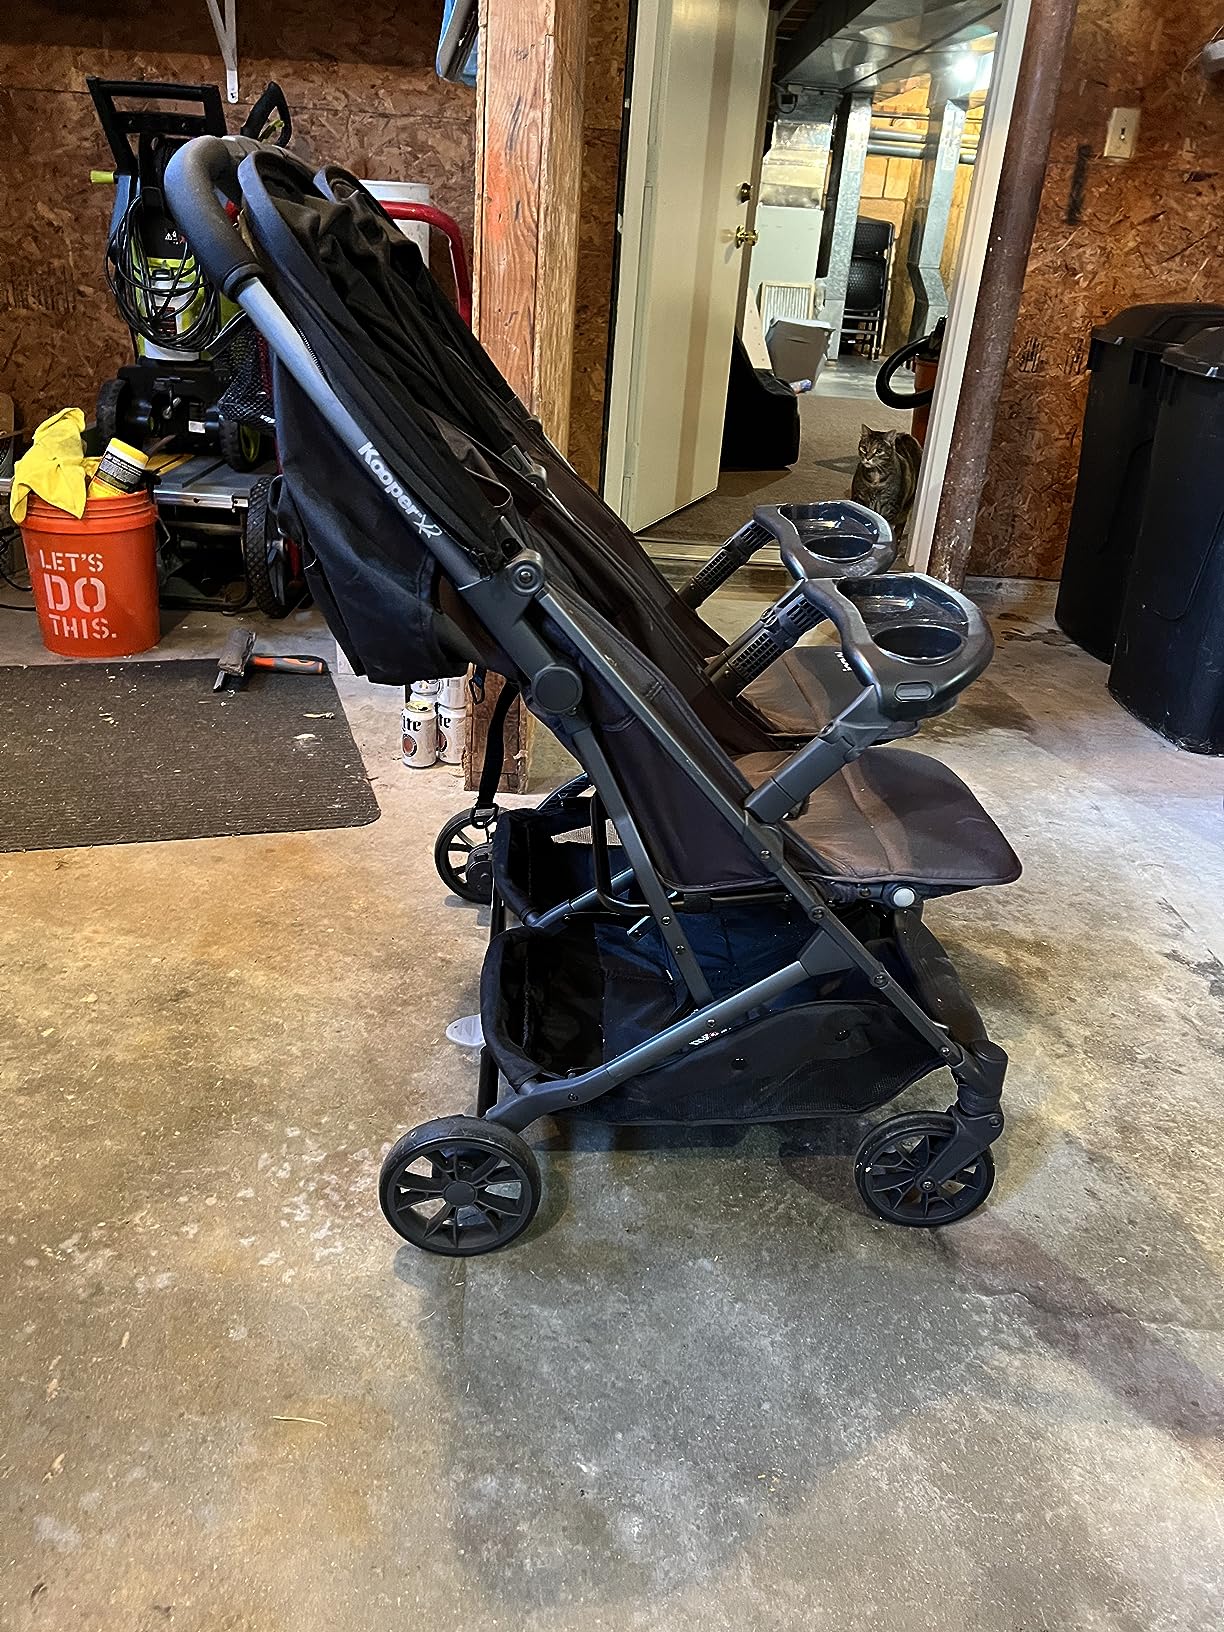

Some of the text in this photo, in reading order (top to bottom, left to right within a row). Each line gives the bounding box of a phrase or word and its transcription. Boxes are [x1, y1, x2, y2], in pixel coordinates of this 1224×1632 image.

[358, 441, 420, 515] Kooper
[39, 549, 104, 573] LET'S
[43, 573, 107, 613] DO
[48, 613, 117, 640] THIS.
